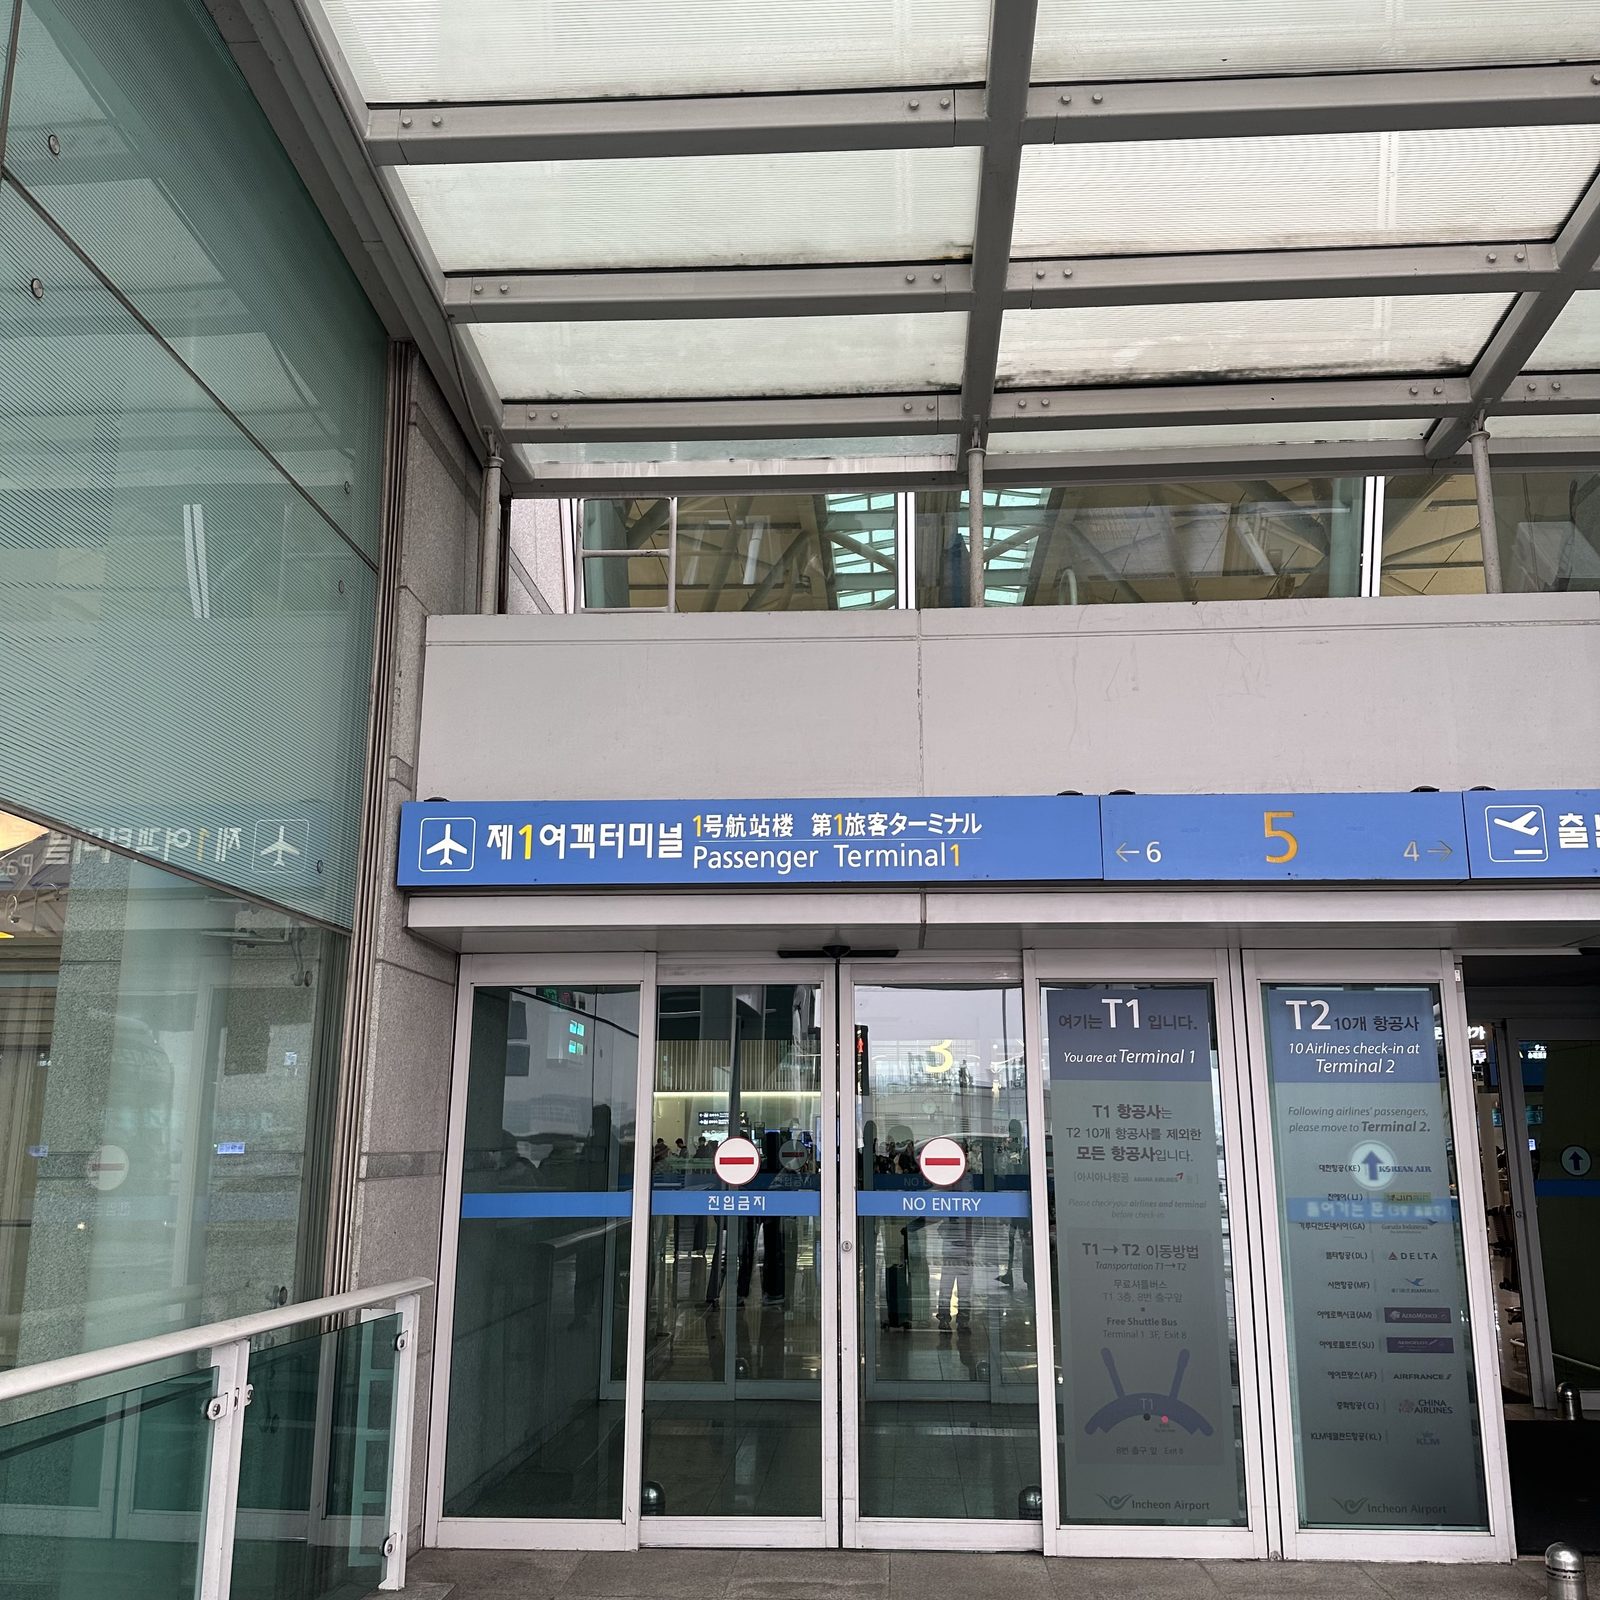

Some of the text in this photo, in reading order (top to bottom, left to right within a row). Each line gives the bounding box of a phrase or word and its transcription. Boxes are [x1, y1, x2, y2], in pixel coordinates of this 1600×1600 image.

[693, 812, 794, 839] 1号航站楼
[811, 811, 982, 838] 第1旅客ターミナル
[1558, 812, 1600, 850] 출
[486, 822, 683, 861] 제1여객터미널
[1263, 811, 1299, 864] 5
[1145, 841, 1162, 863] 6
[1403, 841, 1420, 862] 4
[693, 846, 821, 875] Passenger
[1058, 998, 1198, 1031] 여기는 T1 입니다.
[1285, 1000, 1420, 1032] T2 10개 항공사
[1063, 1049, 1196, 1064] You are at Terminal 1
[1289, 1042, 1420, 1055] 10 Airlines check-in at
[1315, 1058, 1395, 1073] Terminal 2
[1092, 1104, 1173, 1120] T1 항공사는
[1288, 1106, 1334, 1120] Following
[1066, 1127, 1202, 1141] T2 10개 항공사를 제외한
[1289, 1122, 1320, 1135] please
[1321, 1124, 1349, 1133] move
[1349, 1124, 1360, 1133] to
[1361, 1121, 1416, 1133] Terminal
[1076, 1146, 1106, 1162] 모든
[707, 1195, 766, 1212] 진입금지
[902, 1196, 982, 1212] NO ENTRY
[1082, 1243, 1100, 1256] T1
[1122, 1243, 1140, 1256] T2
[1400, 1252, 1439, 1261] DELTA
[1106, 1317, 1126, 1327] Free
[1132, 1499, 1210, 1512] Incheon Airport
[1367, 1499, 1447, 1515] Incheon Airport
